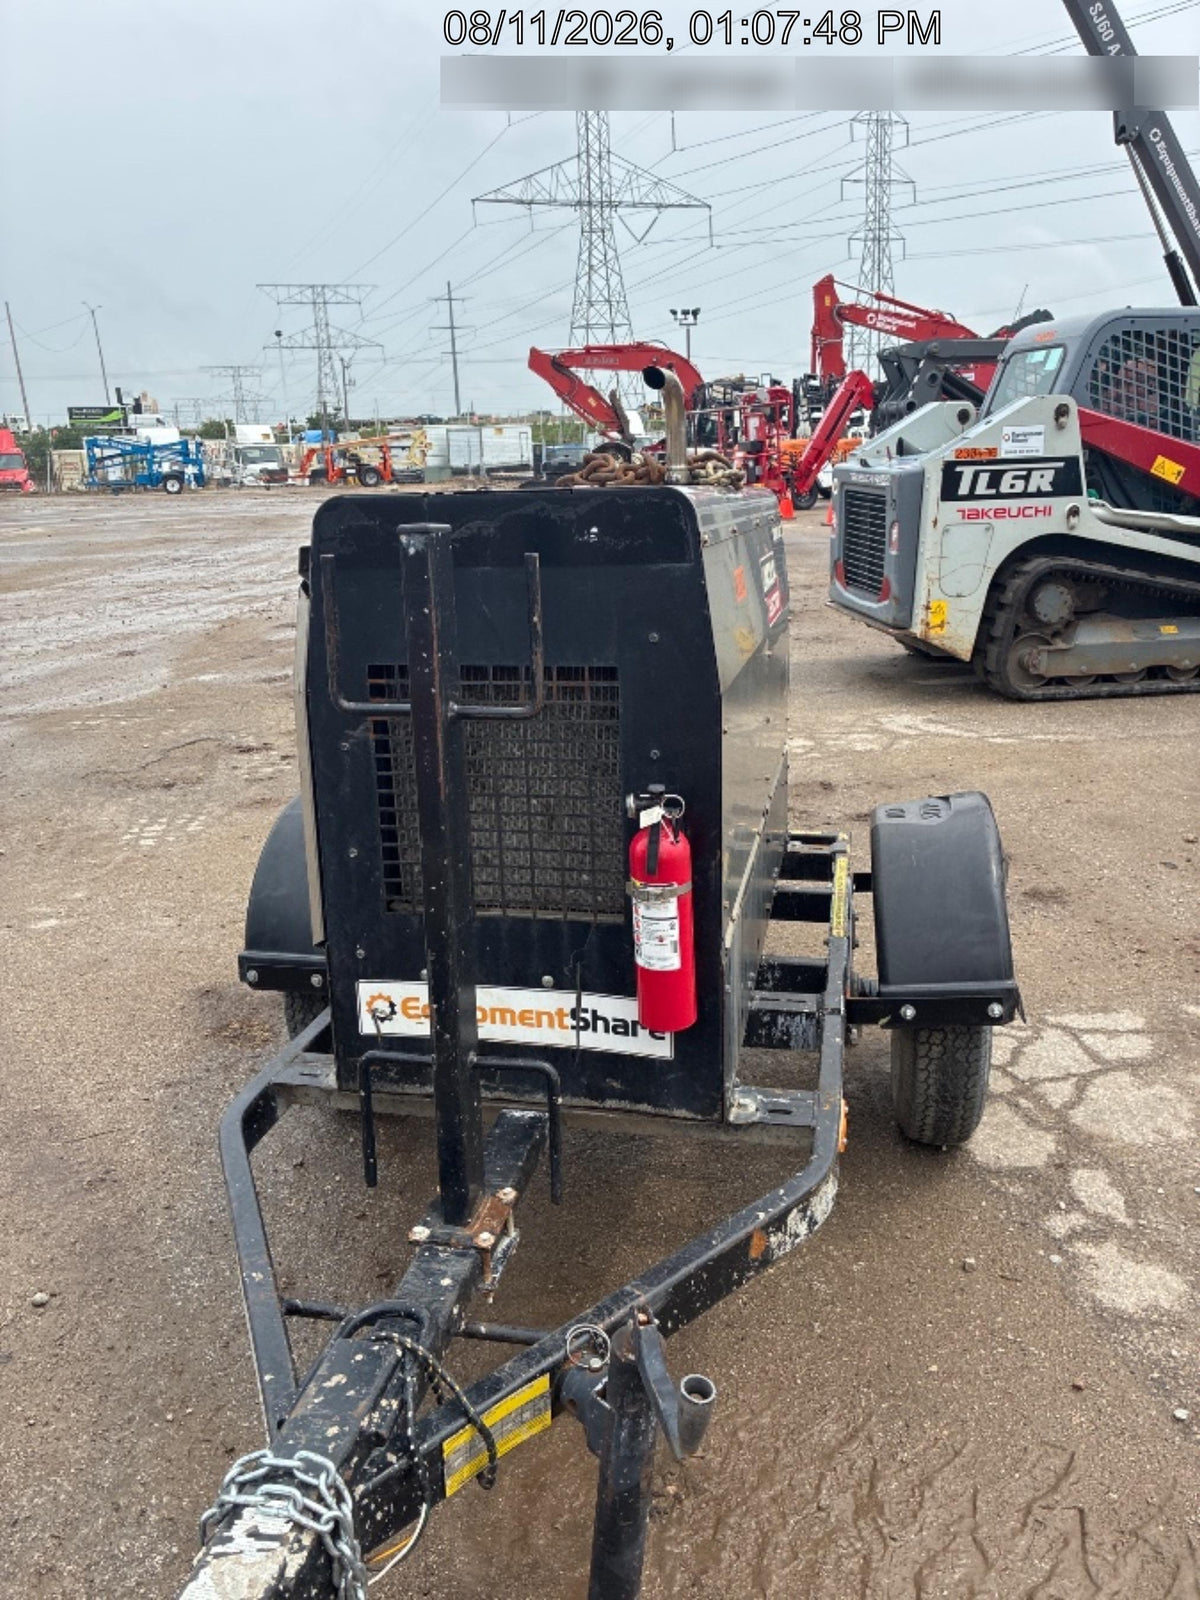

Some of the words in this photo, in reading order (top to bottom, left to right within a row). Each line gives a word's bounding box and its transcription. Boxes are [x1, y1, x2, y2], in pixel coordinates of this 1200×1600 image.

[1089, 2, 1115, 42] SJ60
[954, 461, 1066, 496] TL6R
[956, 505, 1052, 521] TAKEUCHI
[401, 996, 666, 1041] EqpmentShar
